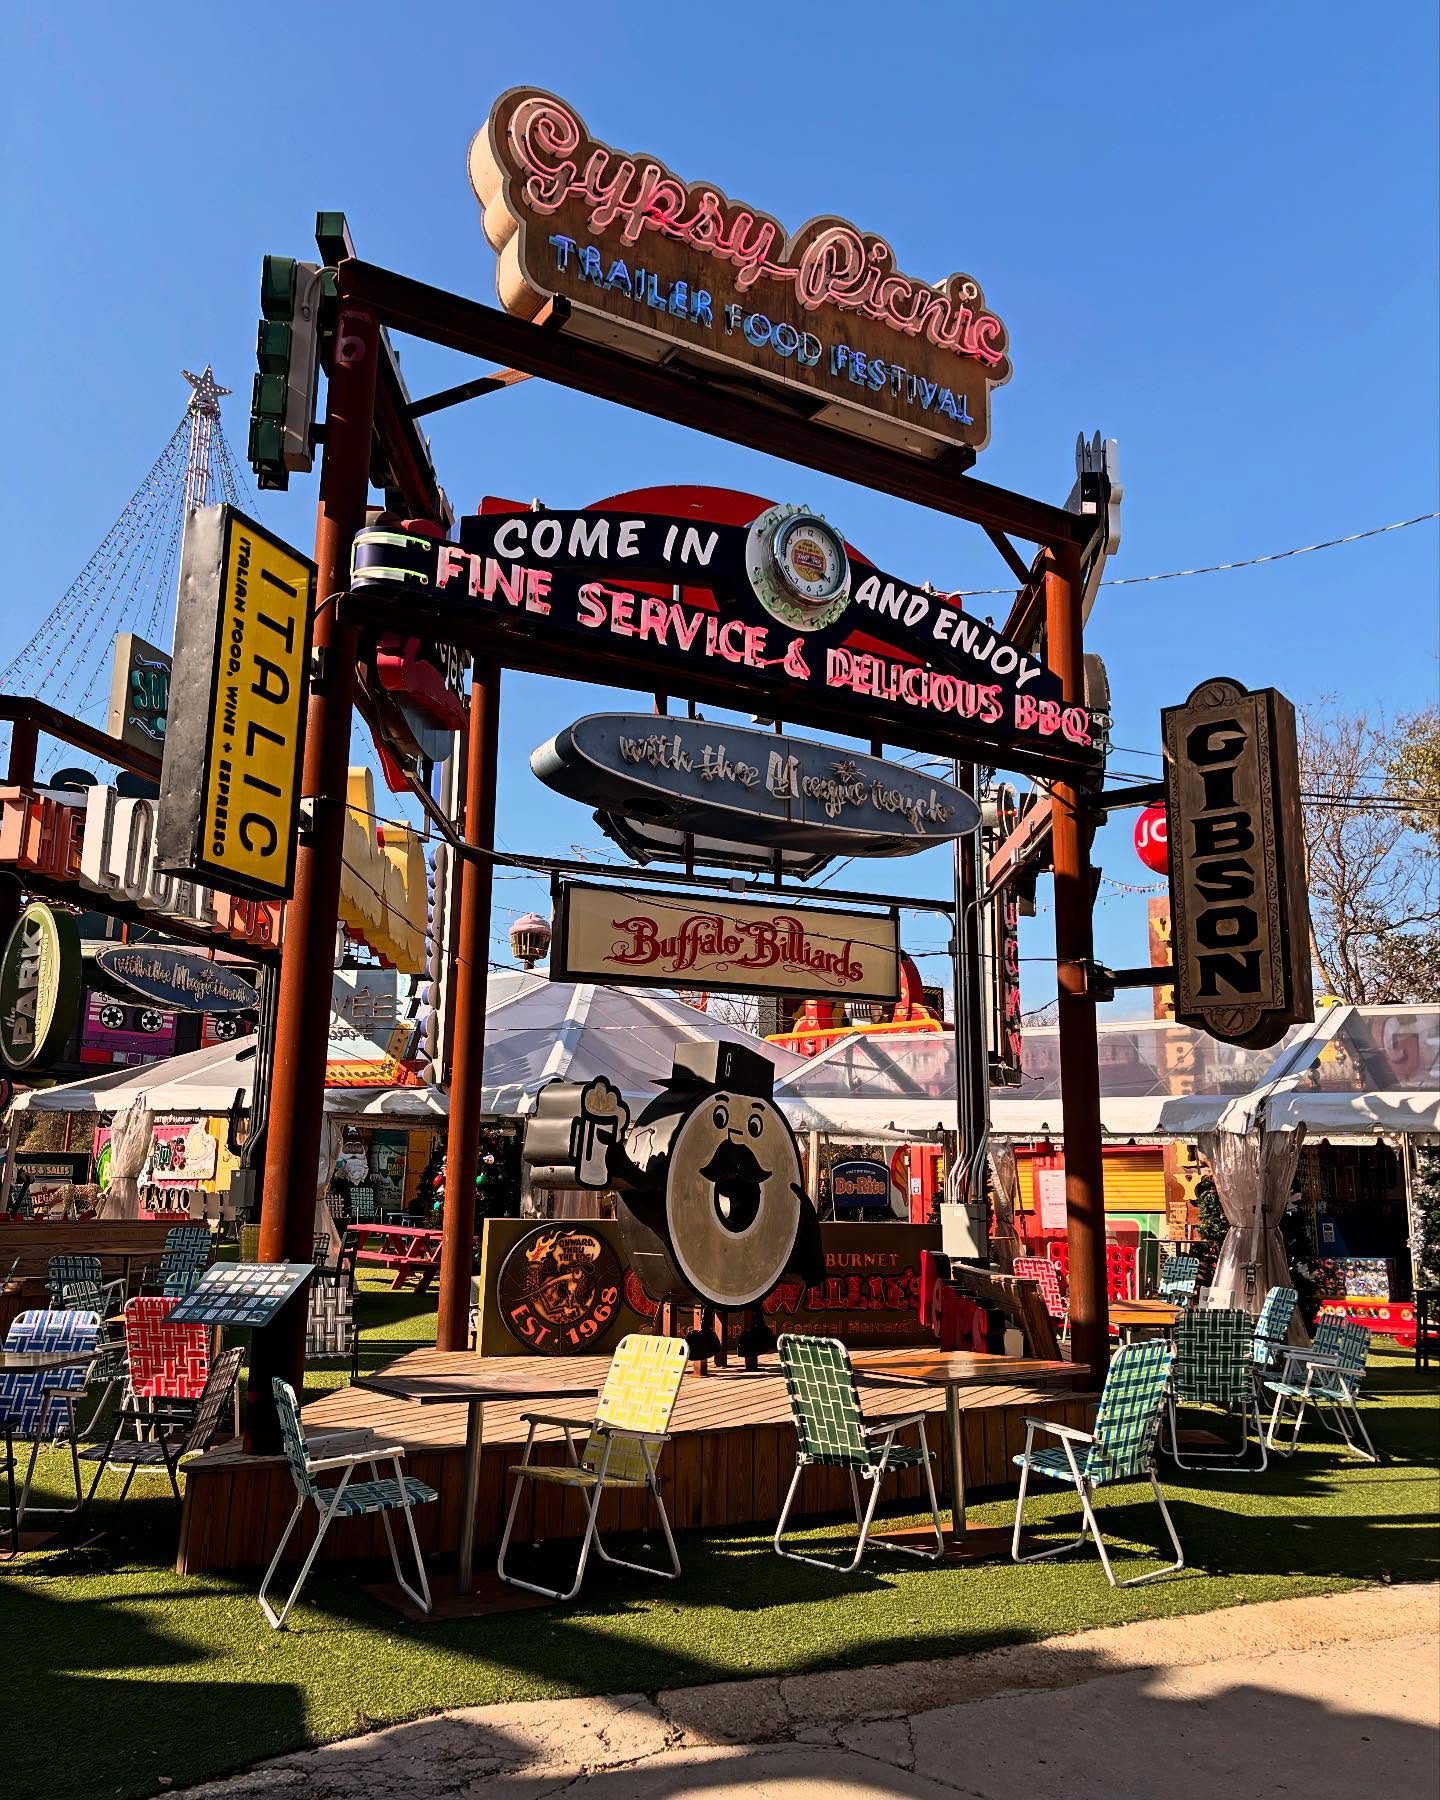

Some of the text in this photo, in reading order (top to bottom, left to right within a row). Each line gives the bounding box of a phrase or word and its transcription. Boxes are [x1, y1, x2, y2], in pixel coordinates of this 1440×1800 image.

[508, 97, 1002, 367] Gypsy Picnic
[549, 234, 974, 426] TRAILER FOOD FESTIVAL
[231, 536, 252, 613] ITALIAN
[493, 518, 646, 560] COME
[662, 523, 719, 566] IN
[855, 575, 930, 627] AND
[932, 608, 1041, 690] ENJOY
[437, 545, 552, 616] FINE
[576, 582, 768, 669] SERVICE
[784, 637, 811, 681] &
[826, 647, 1004, 724] DELICIOUS
[1014, 693, 1092, 747] BBQ
[222, 685, 240, 743] WINE
[239, 568, 299, 859] ITALIC
[212, 758, 233, 858] ESPRESSO
[1186, 718, 1262, 998] GIBSON
[11, 917, 45, 1046] PARK
[602, 915, 864, 987] Buffalo Billiards
[46, 1165, 70, 1175] SALES
[835, 1175, 886, 1195] Do-Rite
[559, 1238, 595, 1247] ONWARD,
[825, 1253, 899, 1267] BURNET
[510, 1303, 552, 1345] EST
[566, 1286, 618, 1345] 1968
